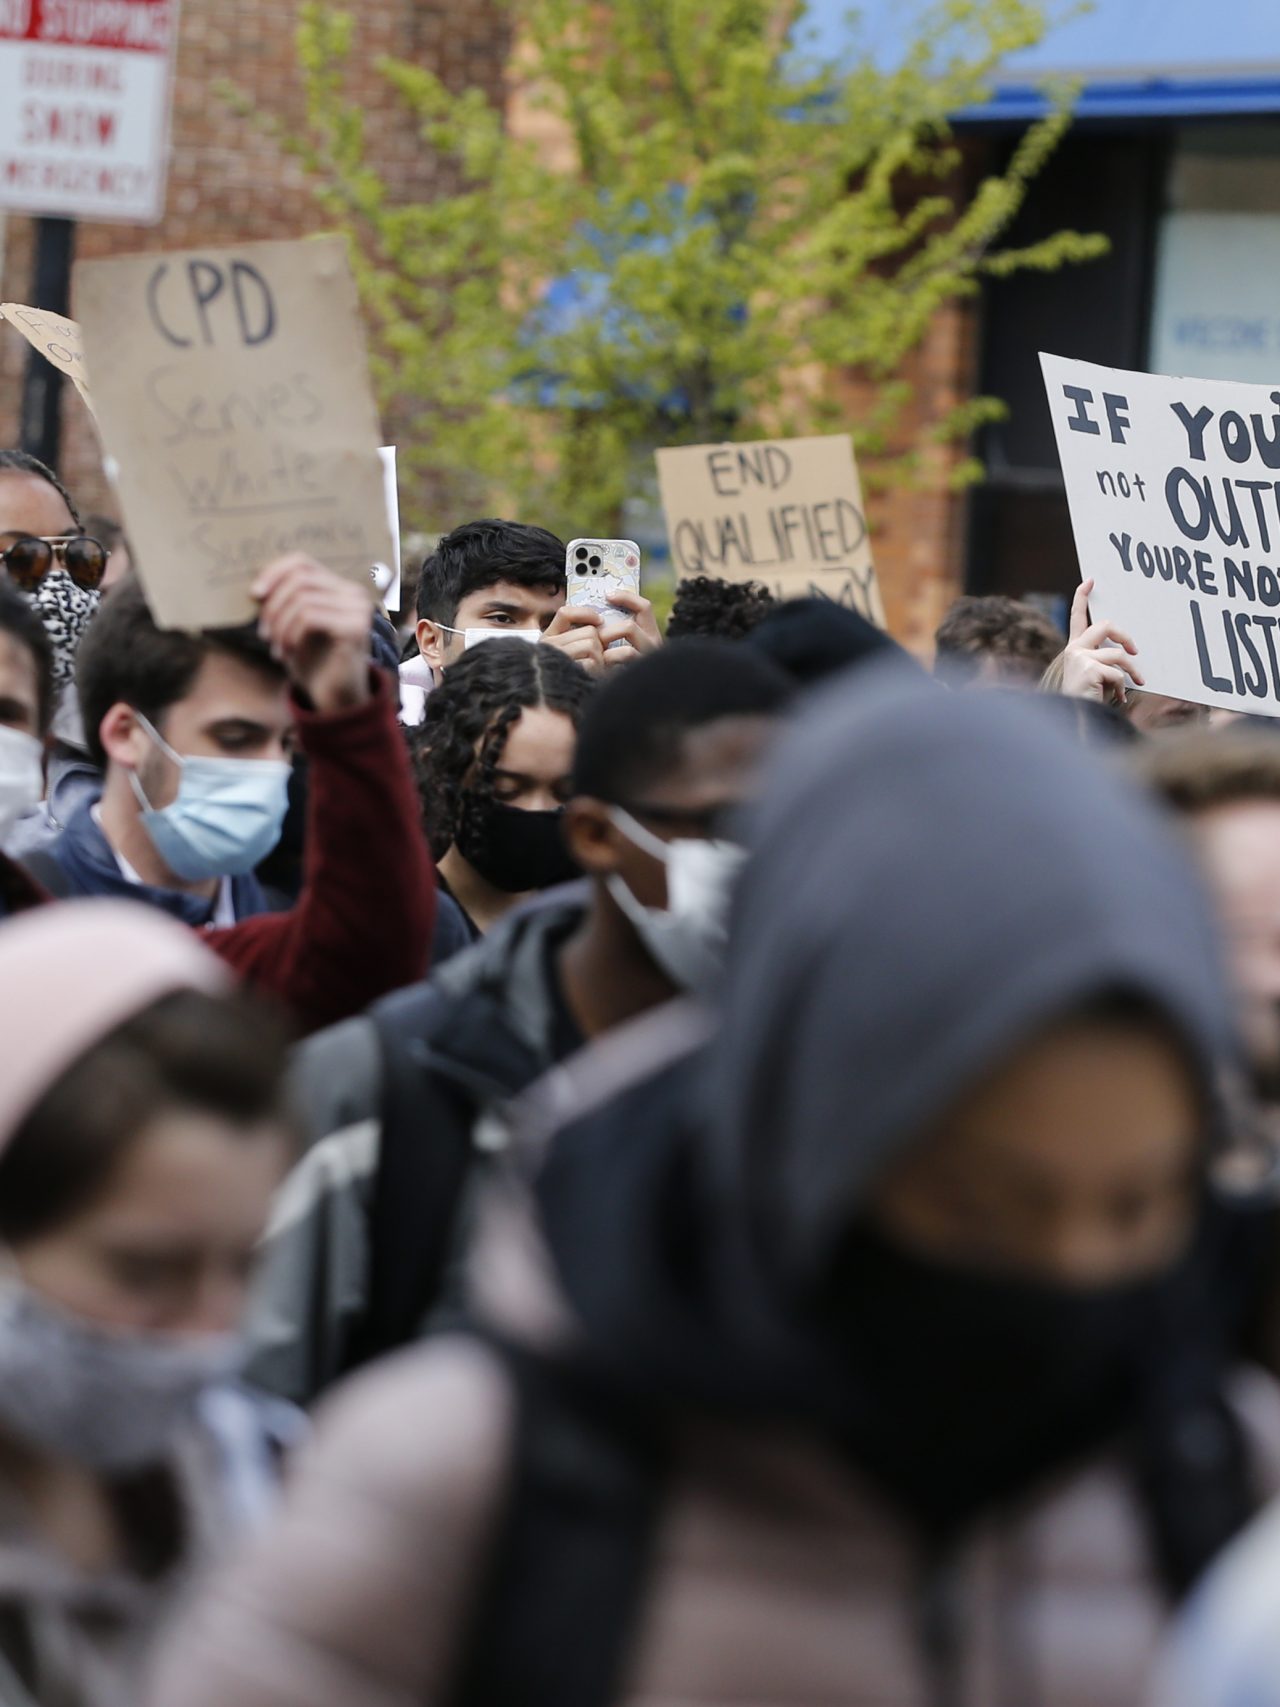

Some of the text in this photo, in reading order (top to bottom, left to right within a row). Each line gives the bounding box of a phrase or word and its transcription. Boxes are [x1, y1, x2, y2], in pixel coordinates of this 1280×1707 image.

[22, 54, 124, 95] DURING
[20, 102, 119, 149] SNOW
[147, 258, 278, 348] CPD
[148, 366, 324, 445] Serves
[1062, 384, 1130, 444] IF
[168, 444, 320, 506] White
[707, 446, 792, 497] END
[1096, 469, 1146, 502] not
[673, 499, 867, 574] QUALIFIED
[1109, 532, 1218, 595] YOURE
